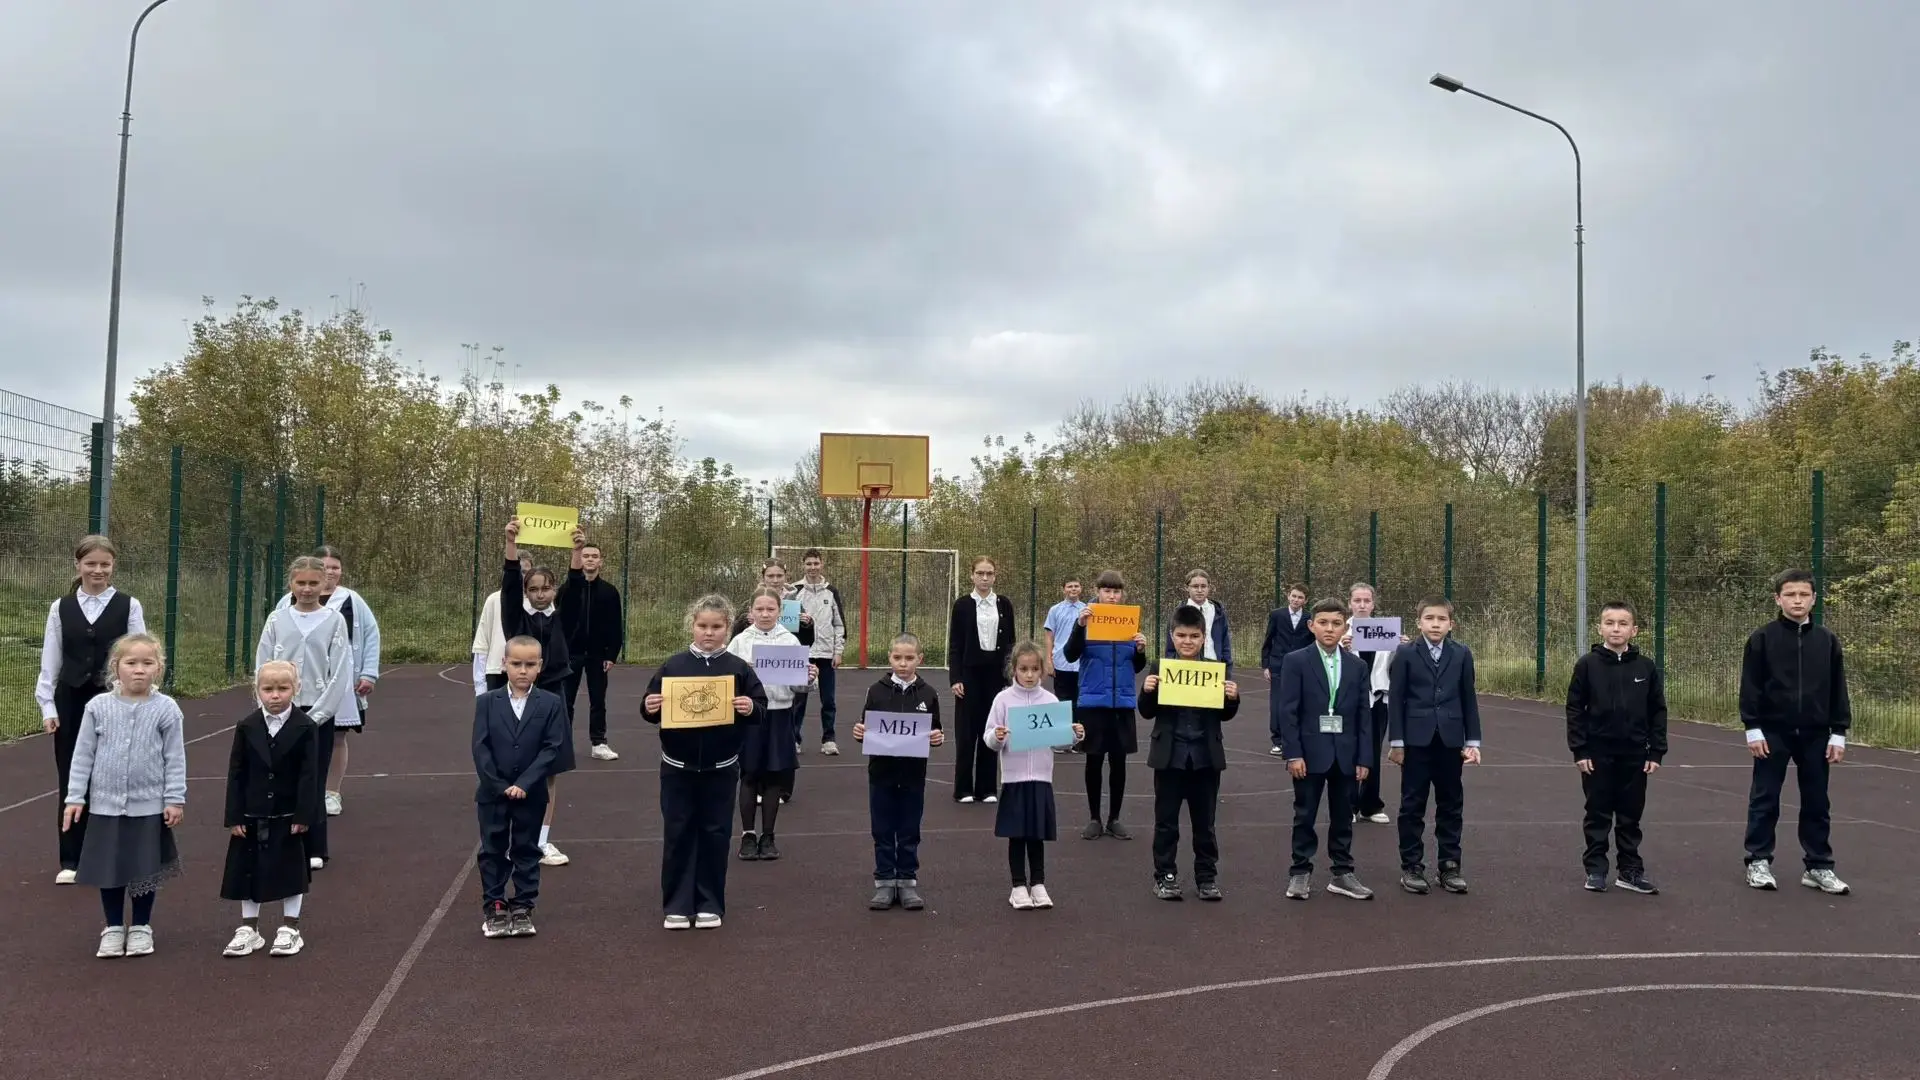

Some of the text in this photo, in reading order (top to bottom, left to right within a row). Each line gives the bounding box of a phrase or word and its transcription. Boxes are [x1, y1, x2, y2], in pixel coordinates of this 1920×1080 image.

[524, 516, 570, 531] СПОРТ
[1091, 615, 1136, 625] ТЕРРОРА
[755, 657, 805, 669] ПРОТИВ
[1164, 668, 1219, 688] МИР!
[879, 718, 919, 736] МЫ
[1027, 712, 1054, 730] ЗА
